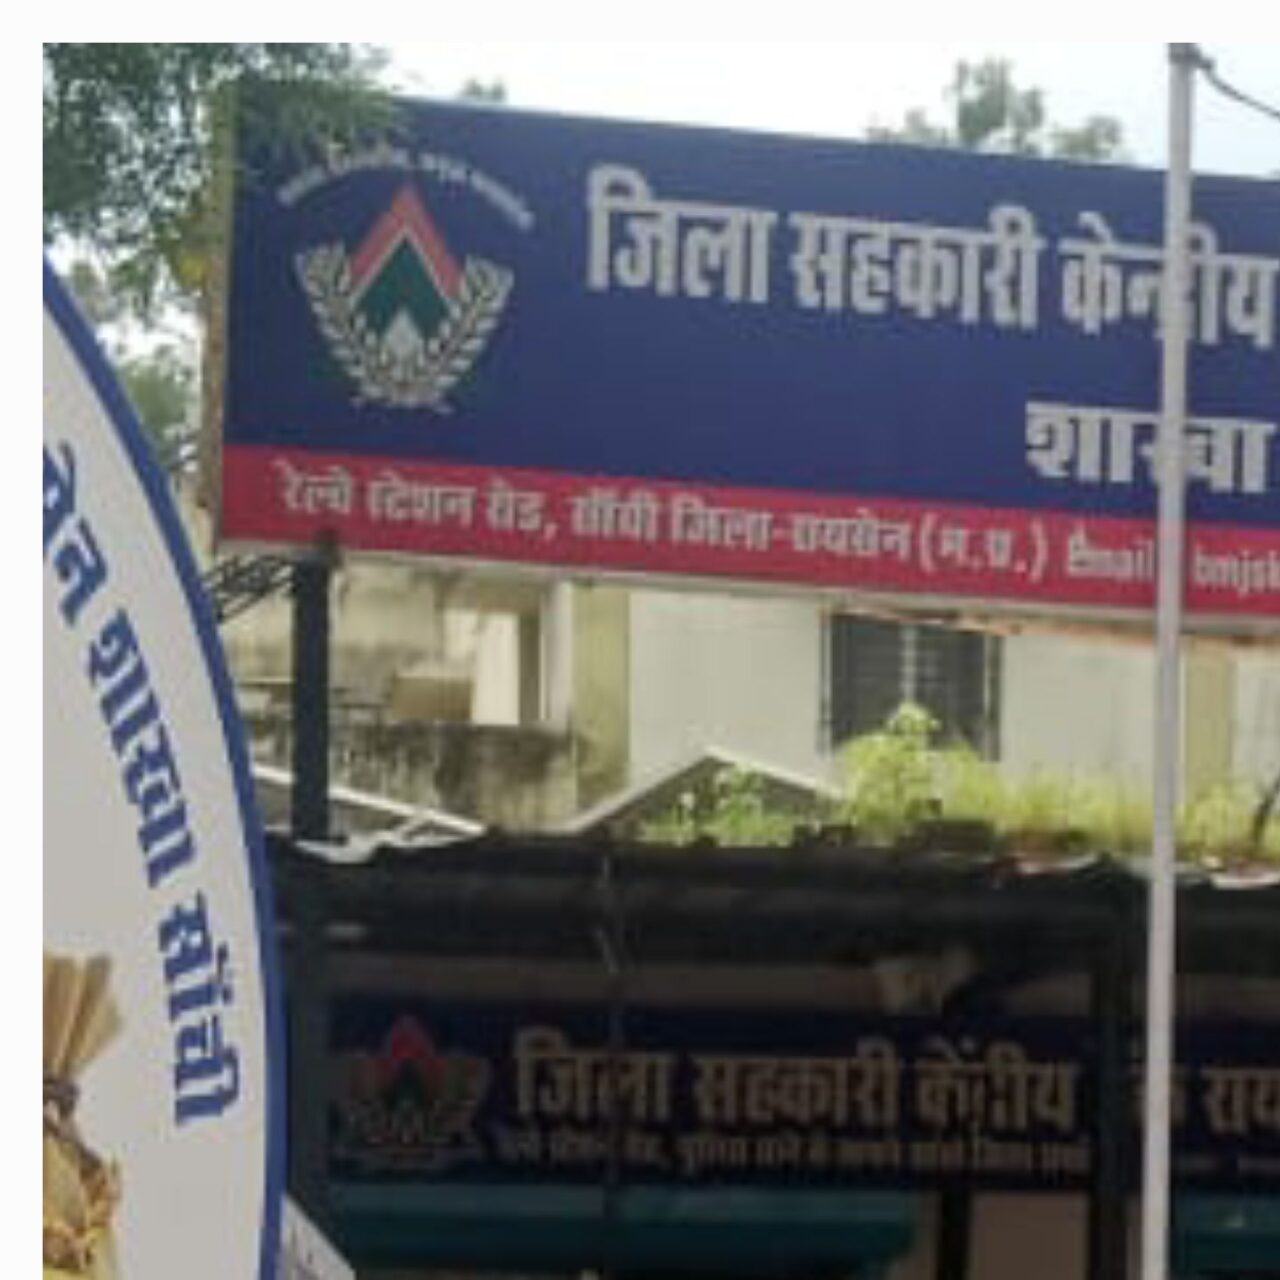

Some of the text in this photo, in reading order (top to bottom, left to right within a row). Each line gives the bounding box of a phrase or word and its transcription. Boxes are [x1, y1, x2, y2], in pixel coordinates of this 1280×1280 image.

[586, 162, 778, 304] जिला
[790, 204, 1046, 328] सहकारी
[86, 607, 195, 890] शाखा
[511, 1023, 678, 1120] जिला
[688, 1034, 908, 1130] सहकारी
